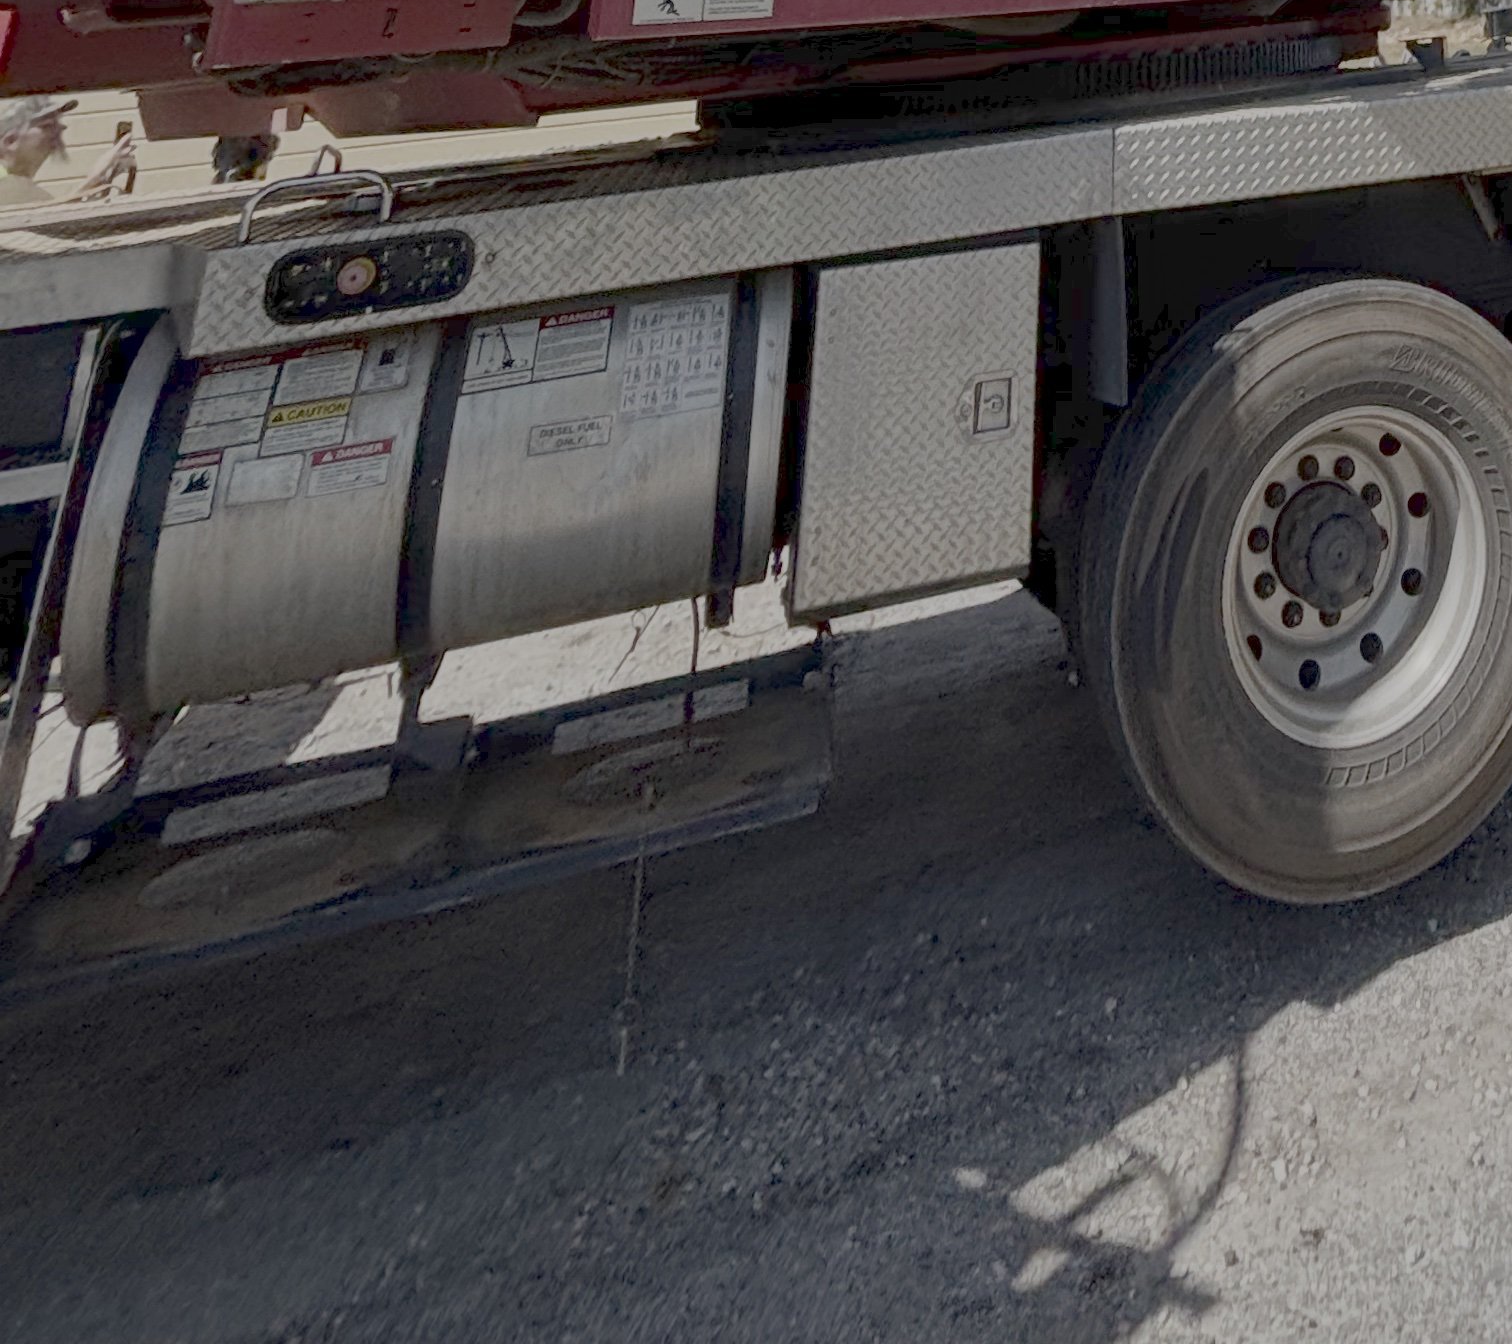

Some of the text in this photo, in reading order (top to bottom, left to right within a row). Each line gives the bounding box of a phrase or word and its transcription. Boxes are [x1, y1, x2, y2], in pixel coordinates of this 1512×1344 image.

[287, 402, 347, 421] CAUTION
[539, 420, 602, 438] DIESEL FUEL
[556, 435, 583, 448] ONLY
